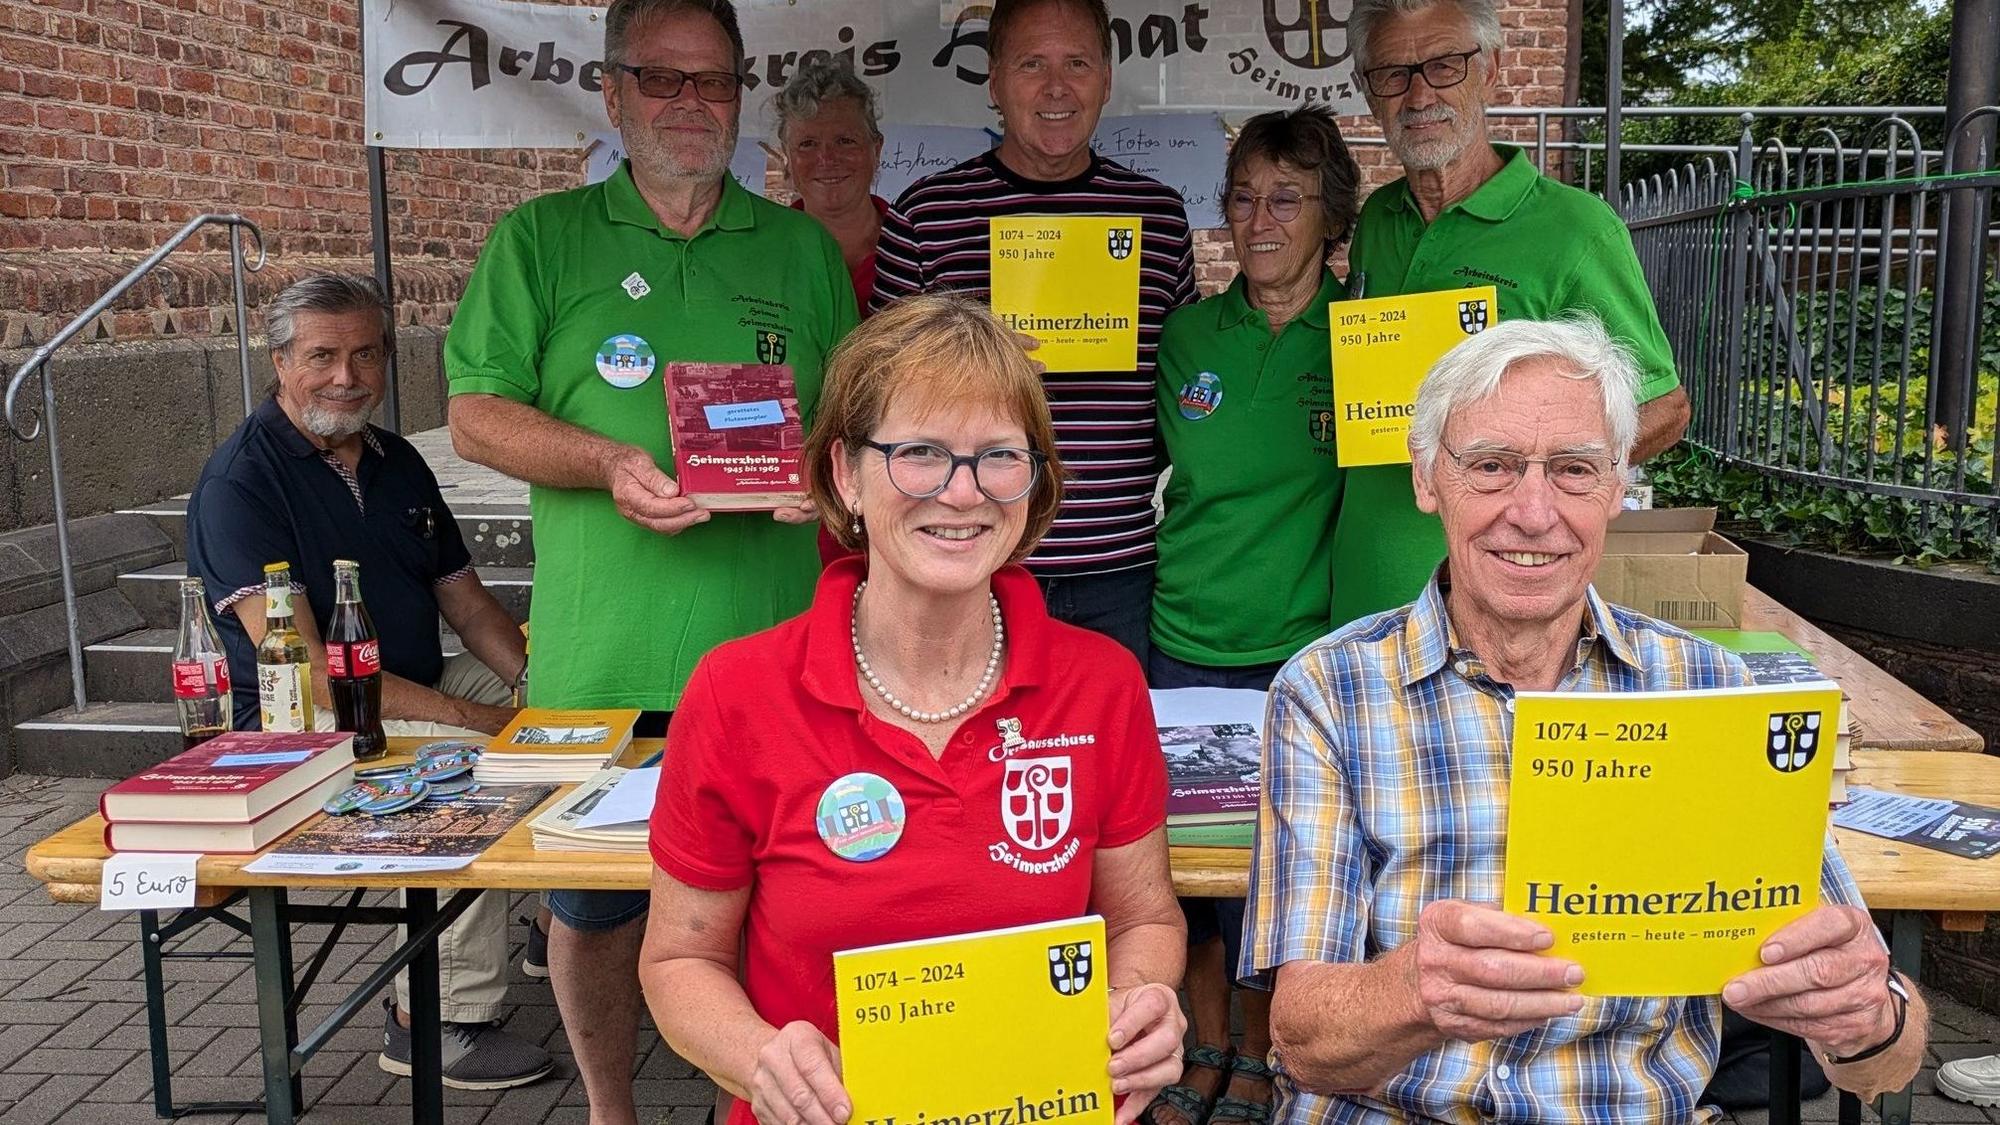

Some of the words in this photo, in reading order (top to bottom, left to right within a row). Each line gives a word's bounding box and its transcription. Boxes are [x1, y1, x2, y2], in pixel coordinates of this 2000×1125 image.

[383, 19, 901, 96] Arbekreis
[1112, 127, 1160, 151] Fotos
[1168, 136, 1198, 148] von
[999, 230, 1024, 240] 1074
[1036, 230, 1061, 240] 2024
[999, 249, 1019, 259] 950
[1023, 248, 1055, 261] Jahre
[1453, 265, 1518, 288] Arbeitskreis
[1002, 312, 1129, 330] Heimerzheim
[1339, 313, 1367, 326] 1074
[1379, 310, 1407, 323] 2024
[1340, 334, 1362, 346] 950
[1366, 331, 1401, 346] Jahre
[1370, 425, 1400, 435] gestern
[686, 454, 779, 467] Heimerzheim
[723, 466, 743, 474] 1945
[759, 465, 780, 473] 1969
[1534, 721, 1588, 741] 1074
[1615, 722, 1668, 741] 2024
[988, 733, 1095, 762] Orsausschuss
[1531, 759, 1574, 778] 950
[1582, 758, 1652, 783] Jahre
[988, 837, 1080, 874] Heimerzheim
[109, 871, 127, 896] 5
[136, 870, 196, 895] Euro
[1524, 877, 1801, 915] Heimerzheim
[1571, 929, 1626, 944] gestern
[1645, 928, 1685, 941] heute
[1703, 926, 1756, 941] morgen
[853, 970, 898, 992] 1074
[921, 962, 965, 984] 2024
[855, 1004, 891, 1025] 950
[899, 999, 956, 1023] Jahre
[865, 1088, 1100, 1125] merzheim
